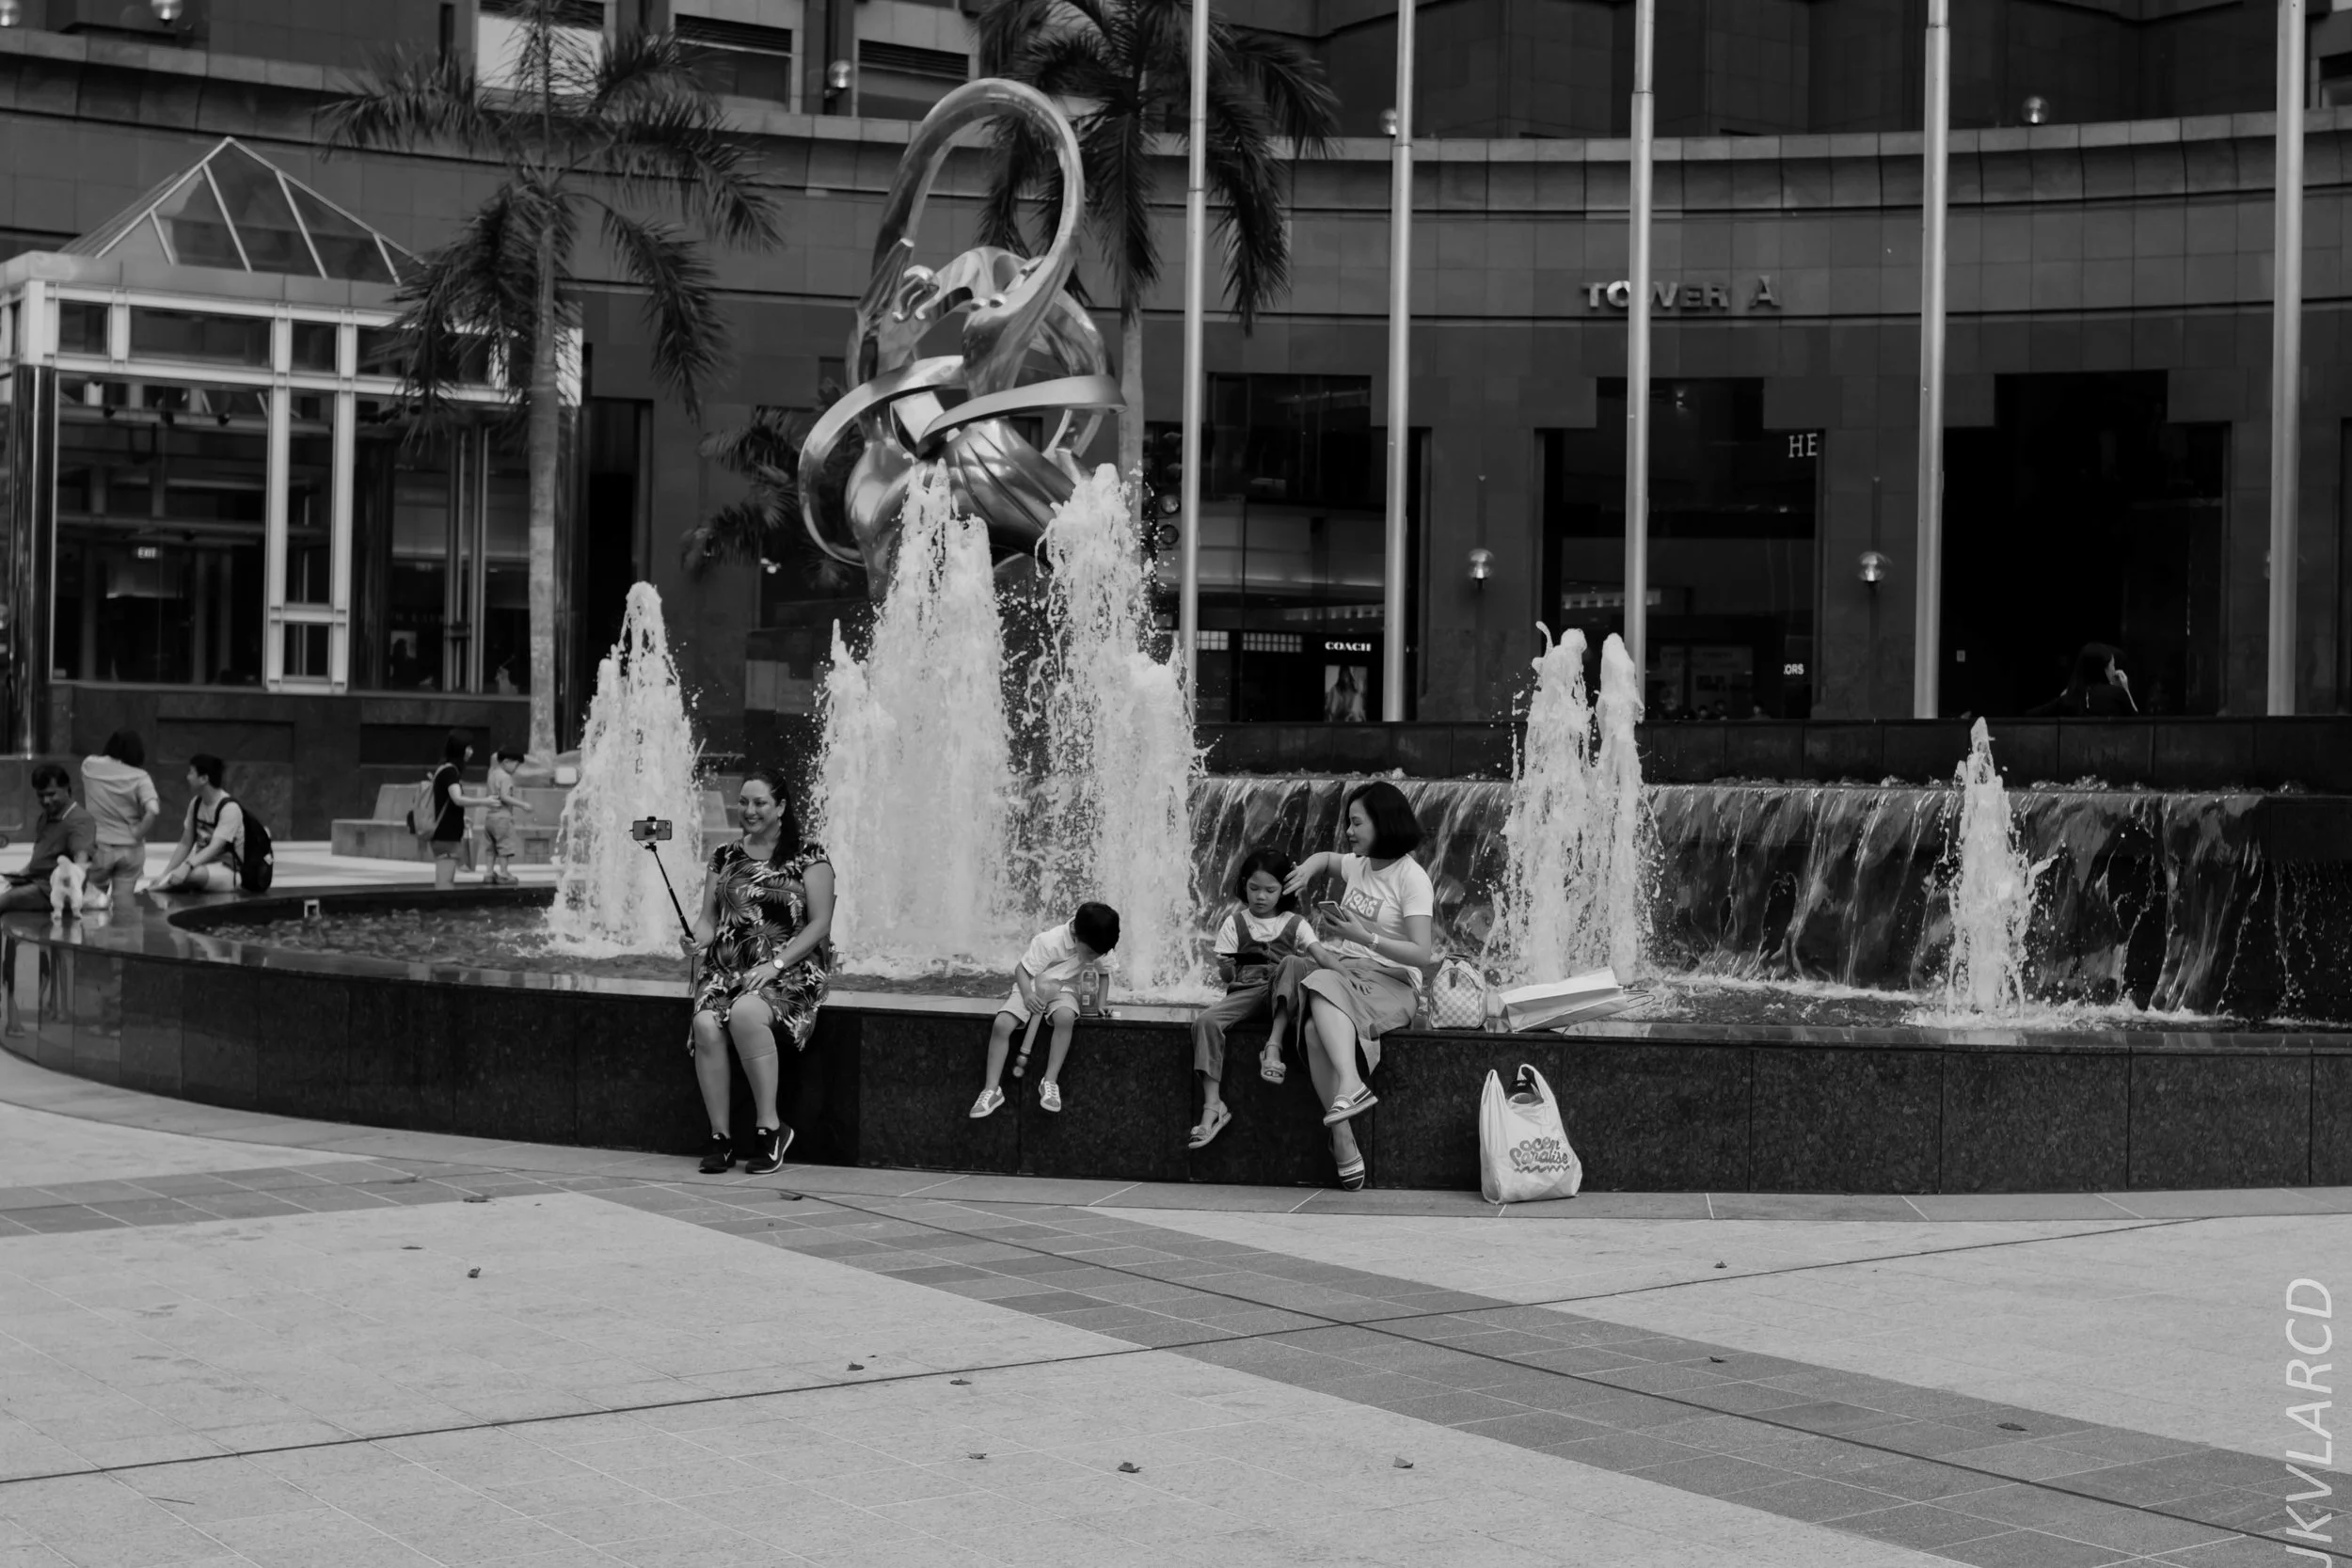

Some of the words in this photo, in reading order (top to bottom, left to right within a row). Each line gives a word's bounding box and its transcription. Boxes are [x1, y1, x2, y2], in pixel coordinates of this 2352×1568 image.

[1581, 279, 1729, 309] TOWER
[1749, 275, 1781, 309] A
[1324, 641, 1373, 653] COACH
